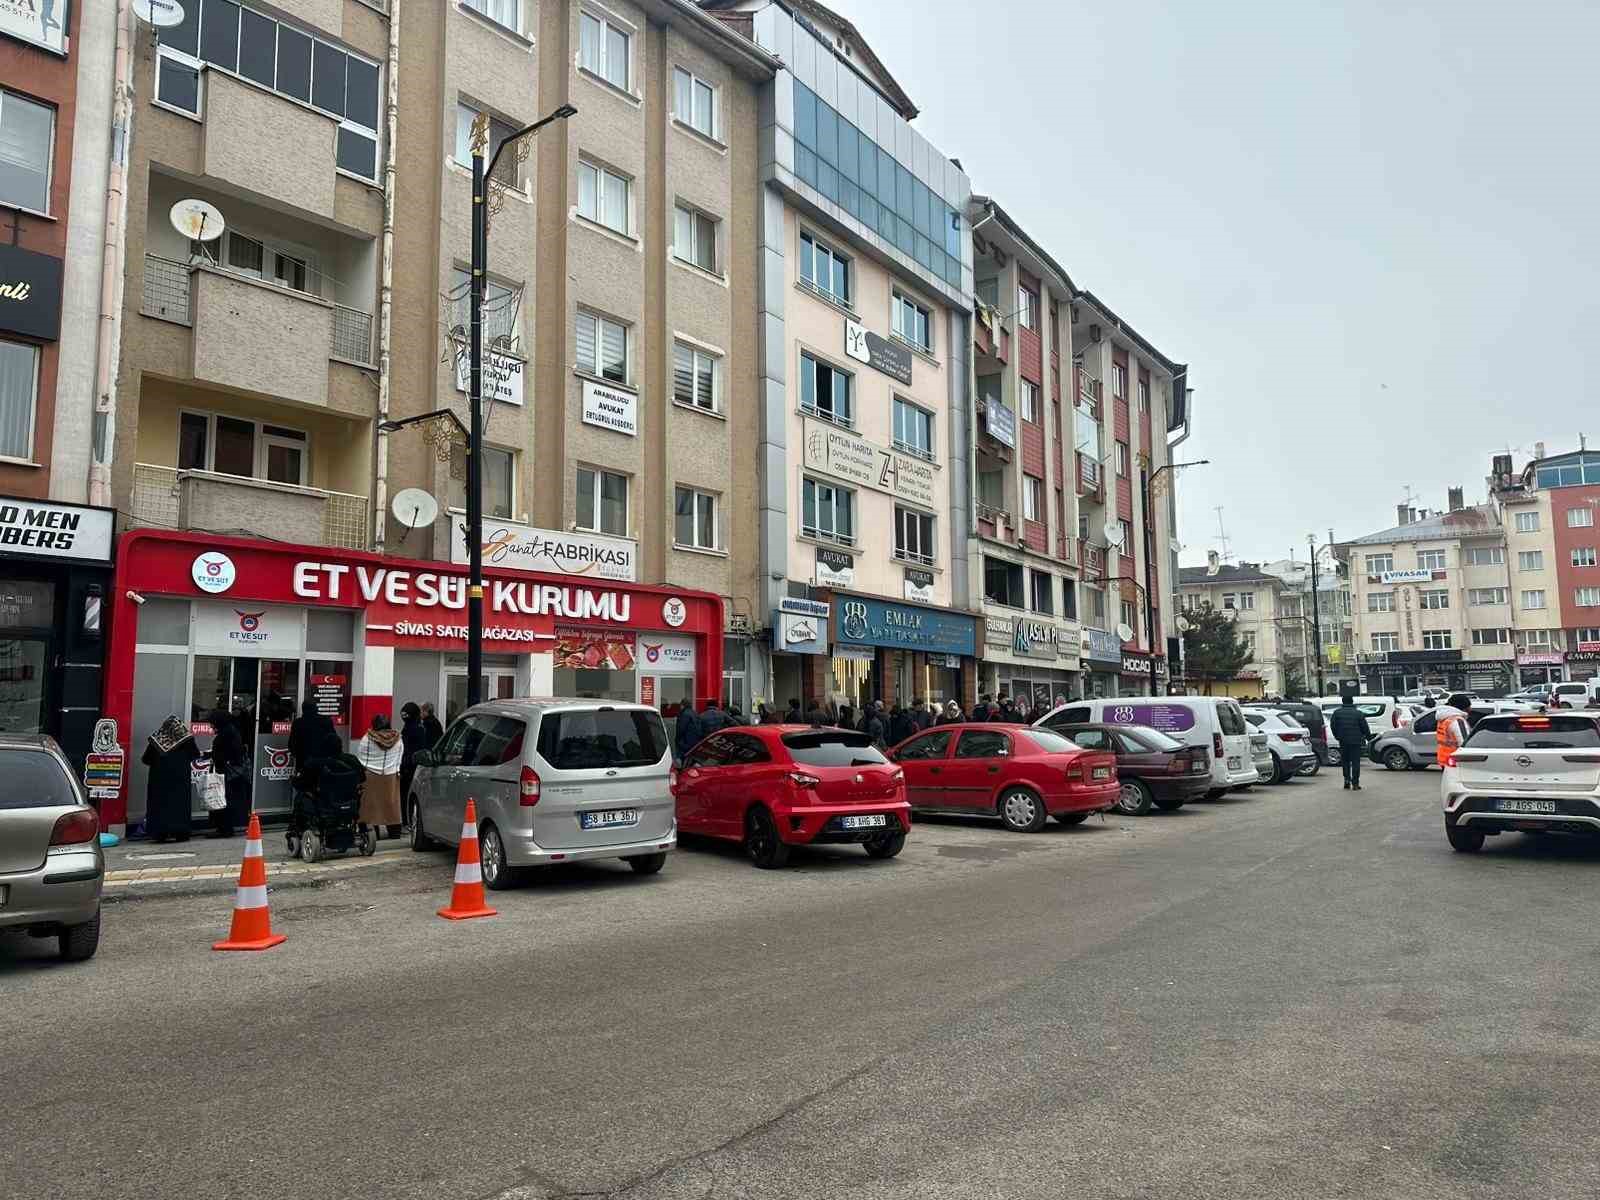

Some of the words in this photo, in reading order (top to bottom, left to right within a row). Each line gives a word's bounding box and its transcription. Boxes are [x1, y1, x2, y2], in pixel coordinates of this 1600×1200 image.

[598, 401, 625, 416] AVUKAT
[22, 508, 81, 531] MEN
[0, 526, 75, 550] BERS
[543, 541, 630, 567] FABRİKASI
[822, 550, 849, 565] AVUKAT
[293, 561, 349, 600] ET
[355, 566, 412, 606] VE
[492, 579, 631, 623] KURUMU
[395, 619, 433, 637] SİVAS
[436, 626, 469, 641] SATIŞ
[480, 624, 535, 642] AĞAZASI
[885, 610, 923, 629] EMLAK
[229, 631, 240, 639] ET
[241, 632, 252, 640] VE
